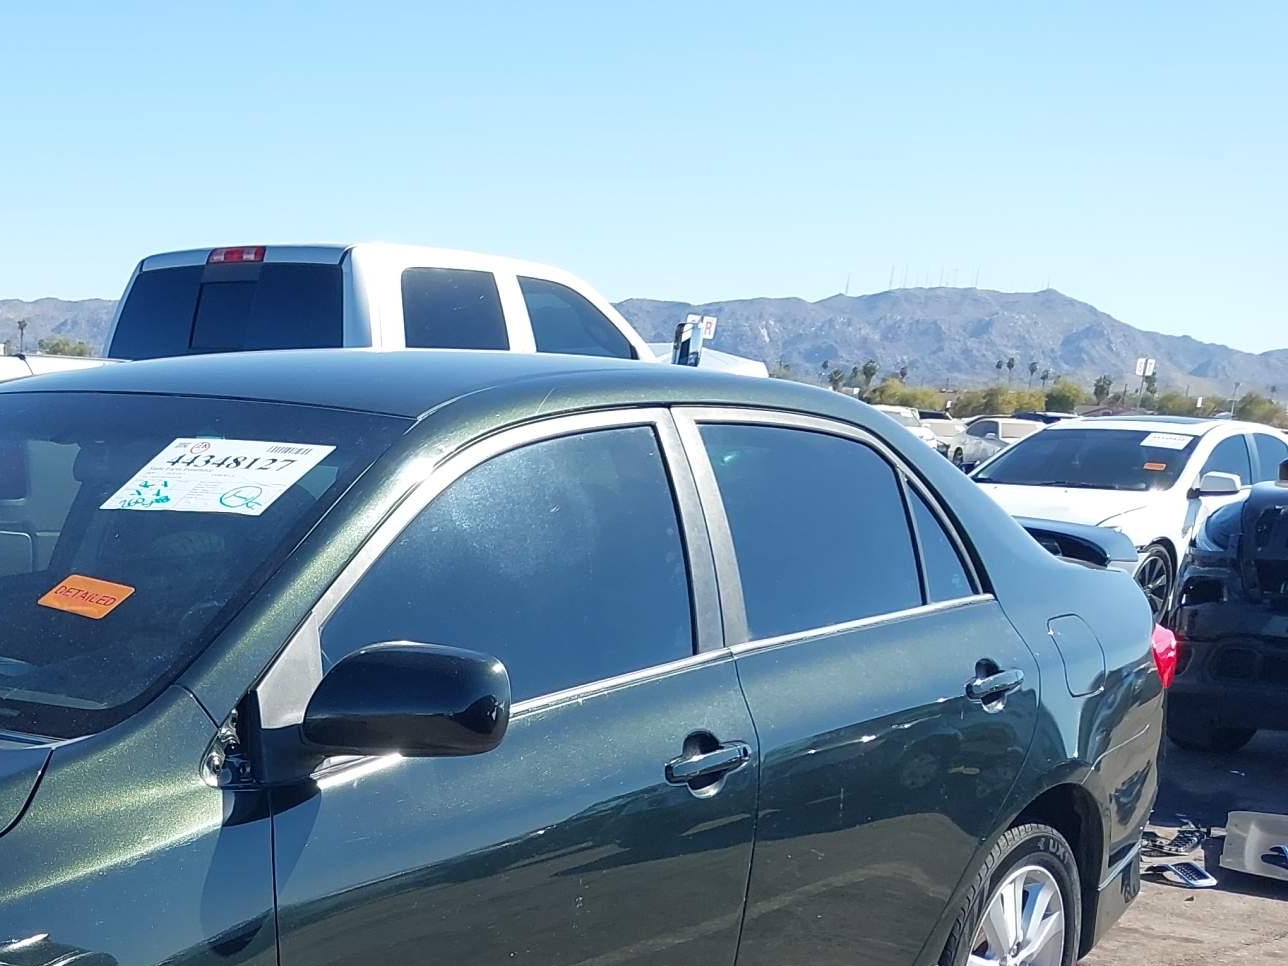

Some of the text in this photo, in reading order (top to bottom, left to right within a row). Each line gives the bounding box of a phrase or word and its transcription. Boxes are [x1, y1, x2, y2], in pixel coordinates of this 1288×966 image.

[704, 321, 713, 336] R
[166, 454, 296, 472] 44348127
[54, 584, 117, 607] DETAILED
